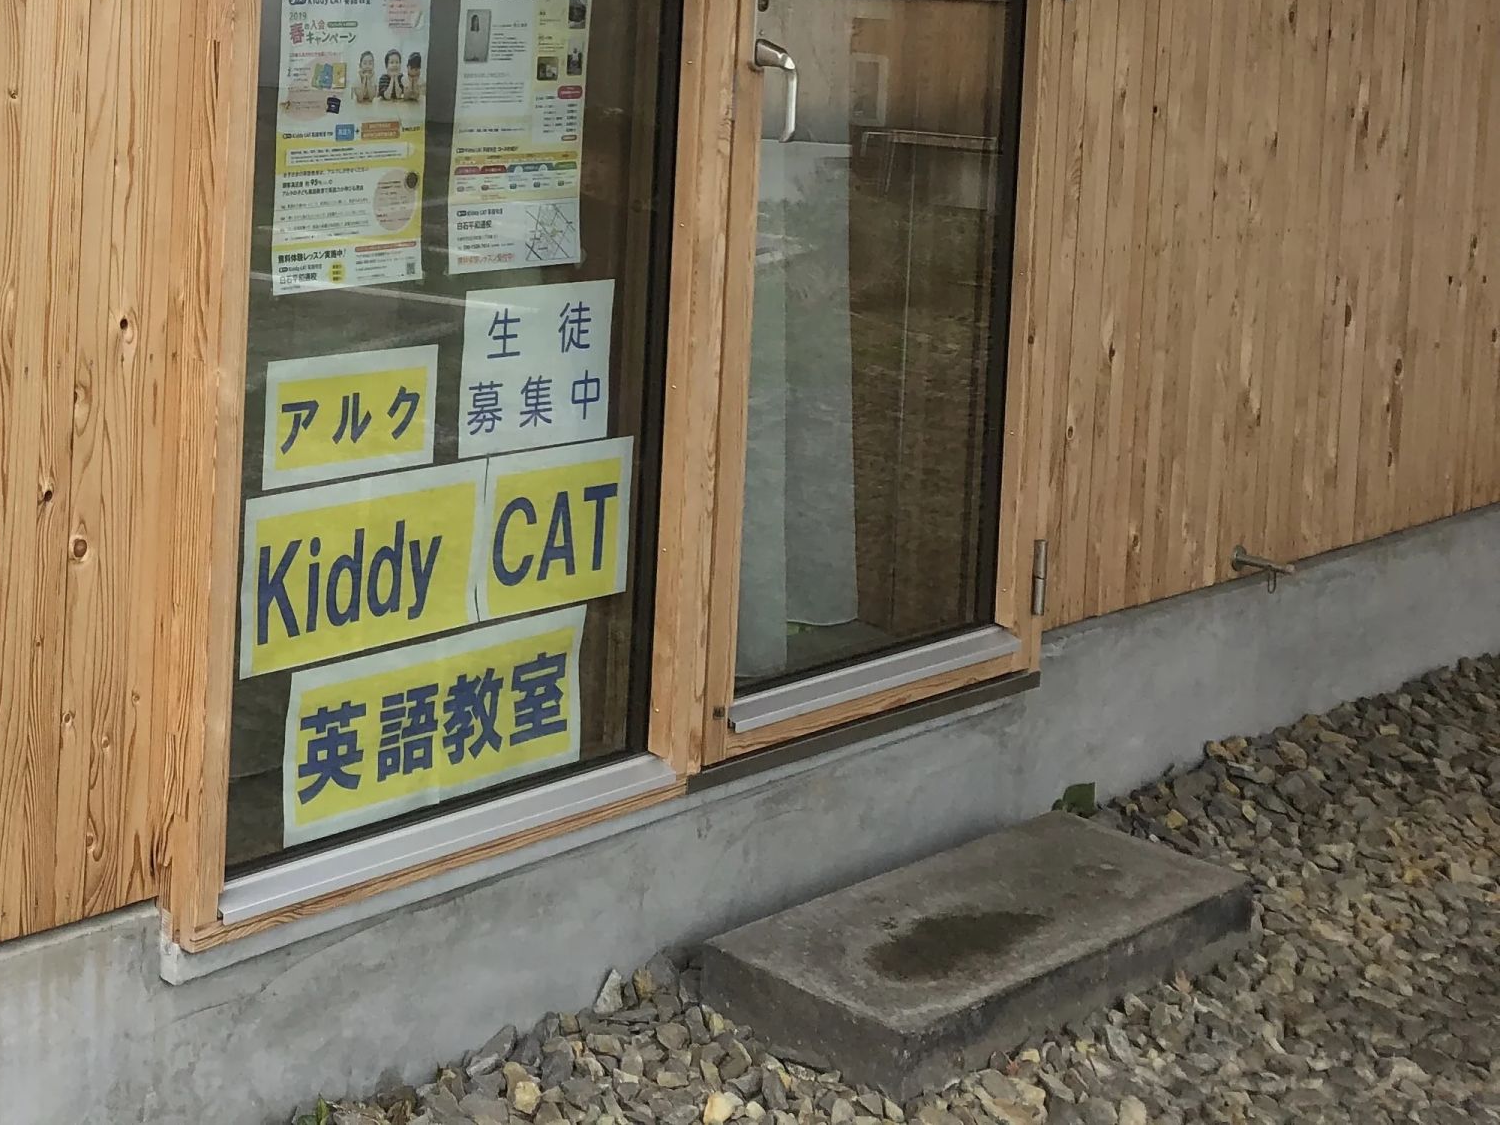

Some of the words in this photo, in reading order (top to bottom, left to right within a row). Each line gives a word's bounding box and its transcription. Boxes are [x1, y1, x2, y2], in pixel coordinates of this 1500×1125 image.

[289, 11, 307, 21] 2019
[280, 385, 421, 456] アルク
[467, 369, 601, 436] 募集中
[256, 519, 444, 646] Kiddy
[492, 482, 619, 587] CAT
[296, 651, 568, 805] 英語教室
